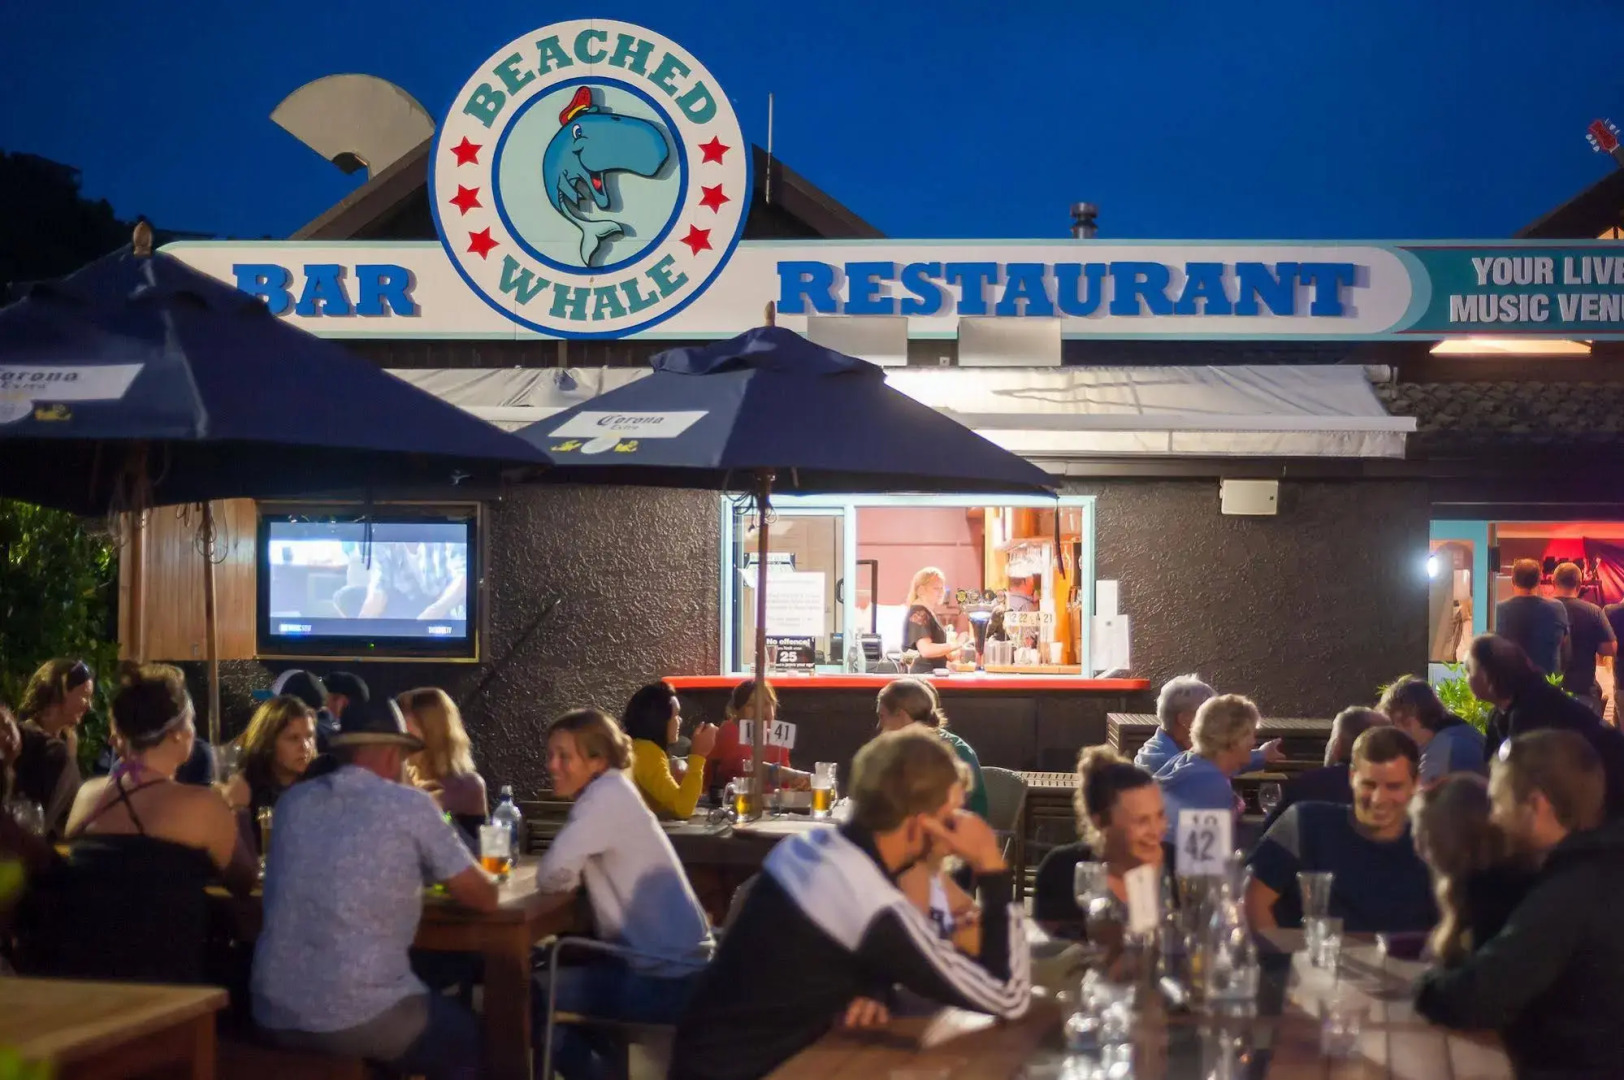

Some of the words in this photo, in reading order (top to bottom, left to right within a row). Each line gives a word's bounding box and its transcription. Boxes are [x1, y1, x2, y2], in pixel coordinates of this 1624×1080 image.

[463, 29, 717, 129] BEACHED
[1472, 256, 1554, 286] YOUR
[232, 263, 416, 316] BAR
[498, 253, 690, 322] WHALE
[776, 261, 1355, 317] RESTAURANT
[1450, 294, 1550, 323] MUSIC
[0, 371, 79, 382] orona
[597, 414, 664, 426] Corona
[766, 637, 778, 645] No
[780, 651, 798, 662] 25
[774, 723, 790, 740] 41
[1184, 830, 1216, 861] 42
